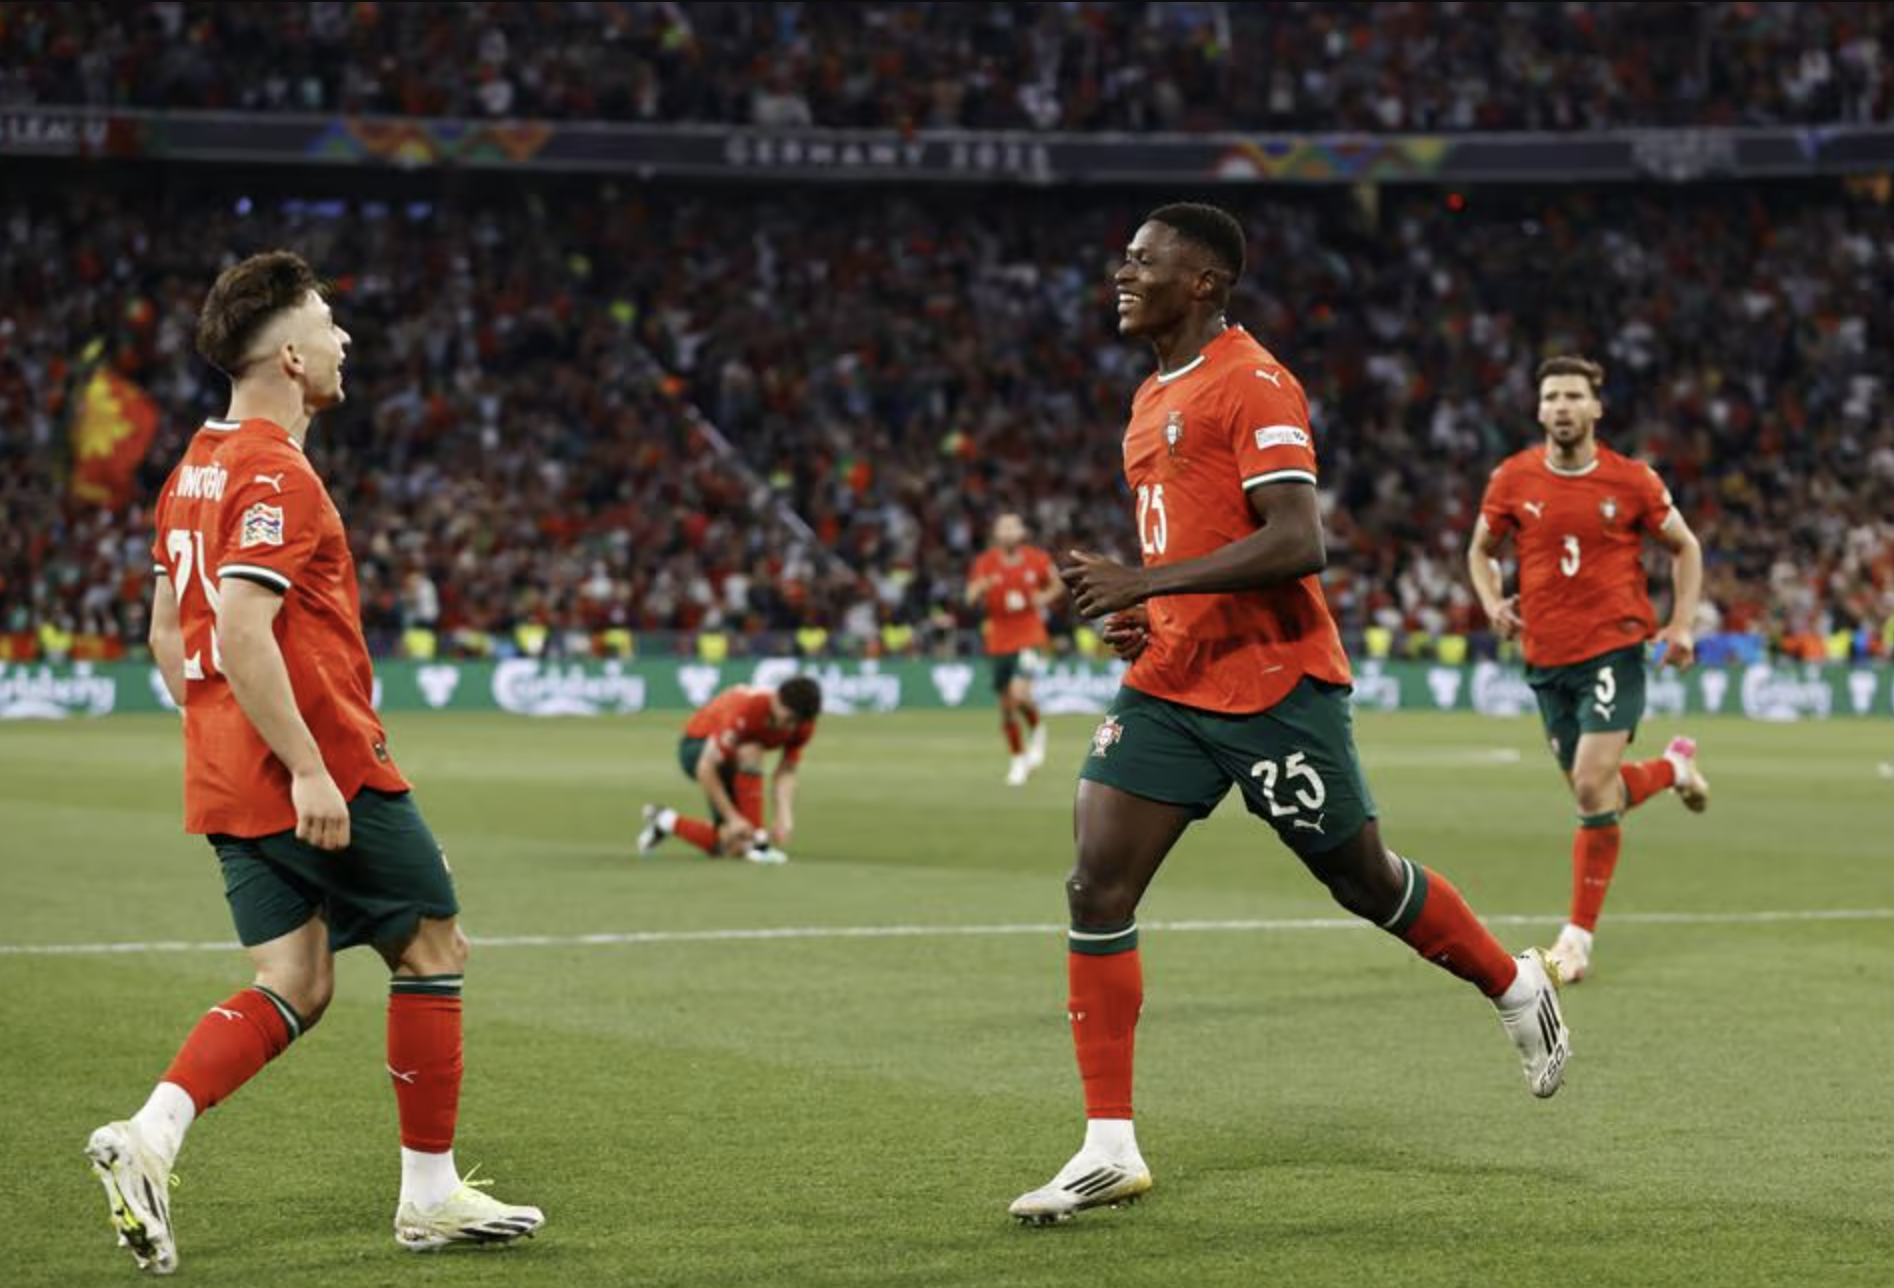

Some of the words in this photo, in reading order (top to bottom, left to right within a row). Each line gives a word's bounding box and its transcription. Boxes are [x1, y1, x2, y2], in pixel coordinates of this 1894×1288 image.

[1137, 484, 1167, 554] 25
[1561, 535, 1580, 577] 3
[492, 658, 646, 716] Carlsberg
[1251, 751, 1325, 816] 25
